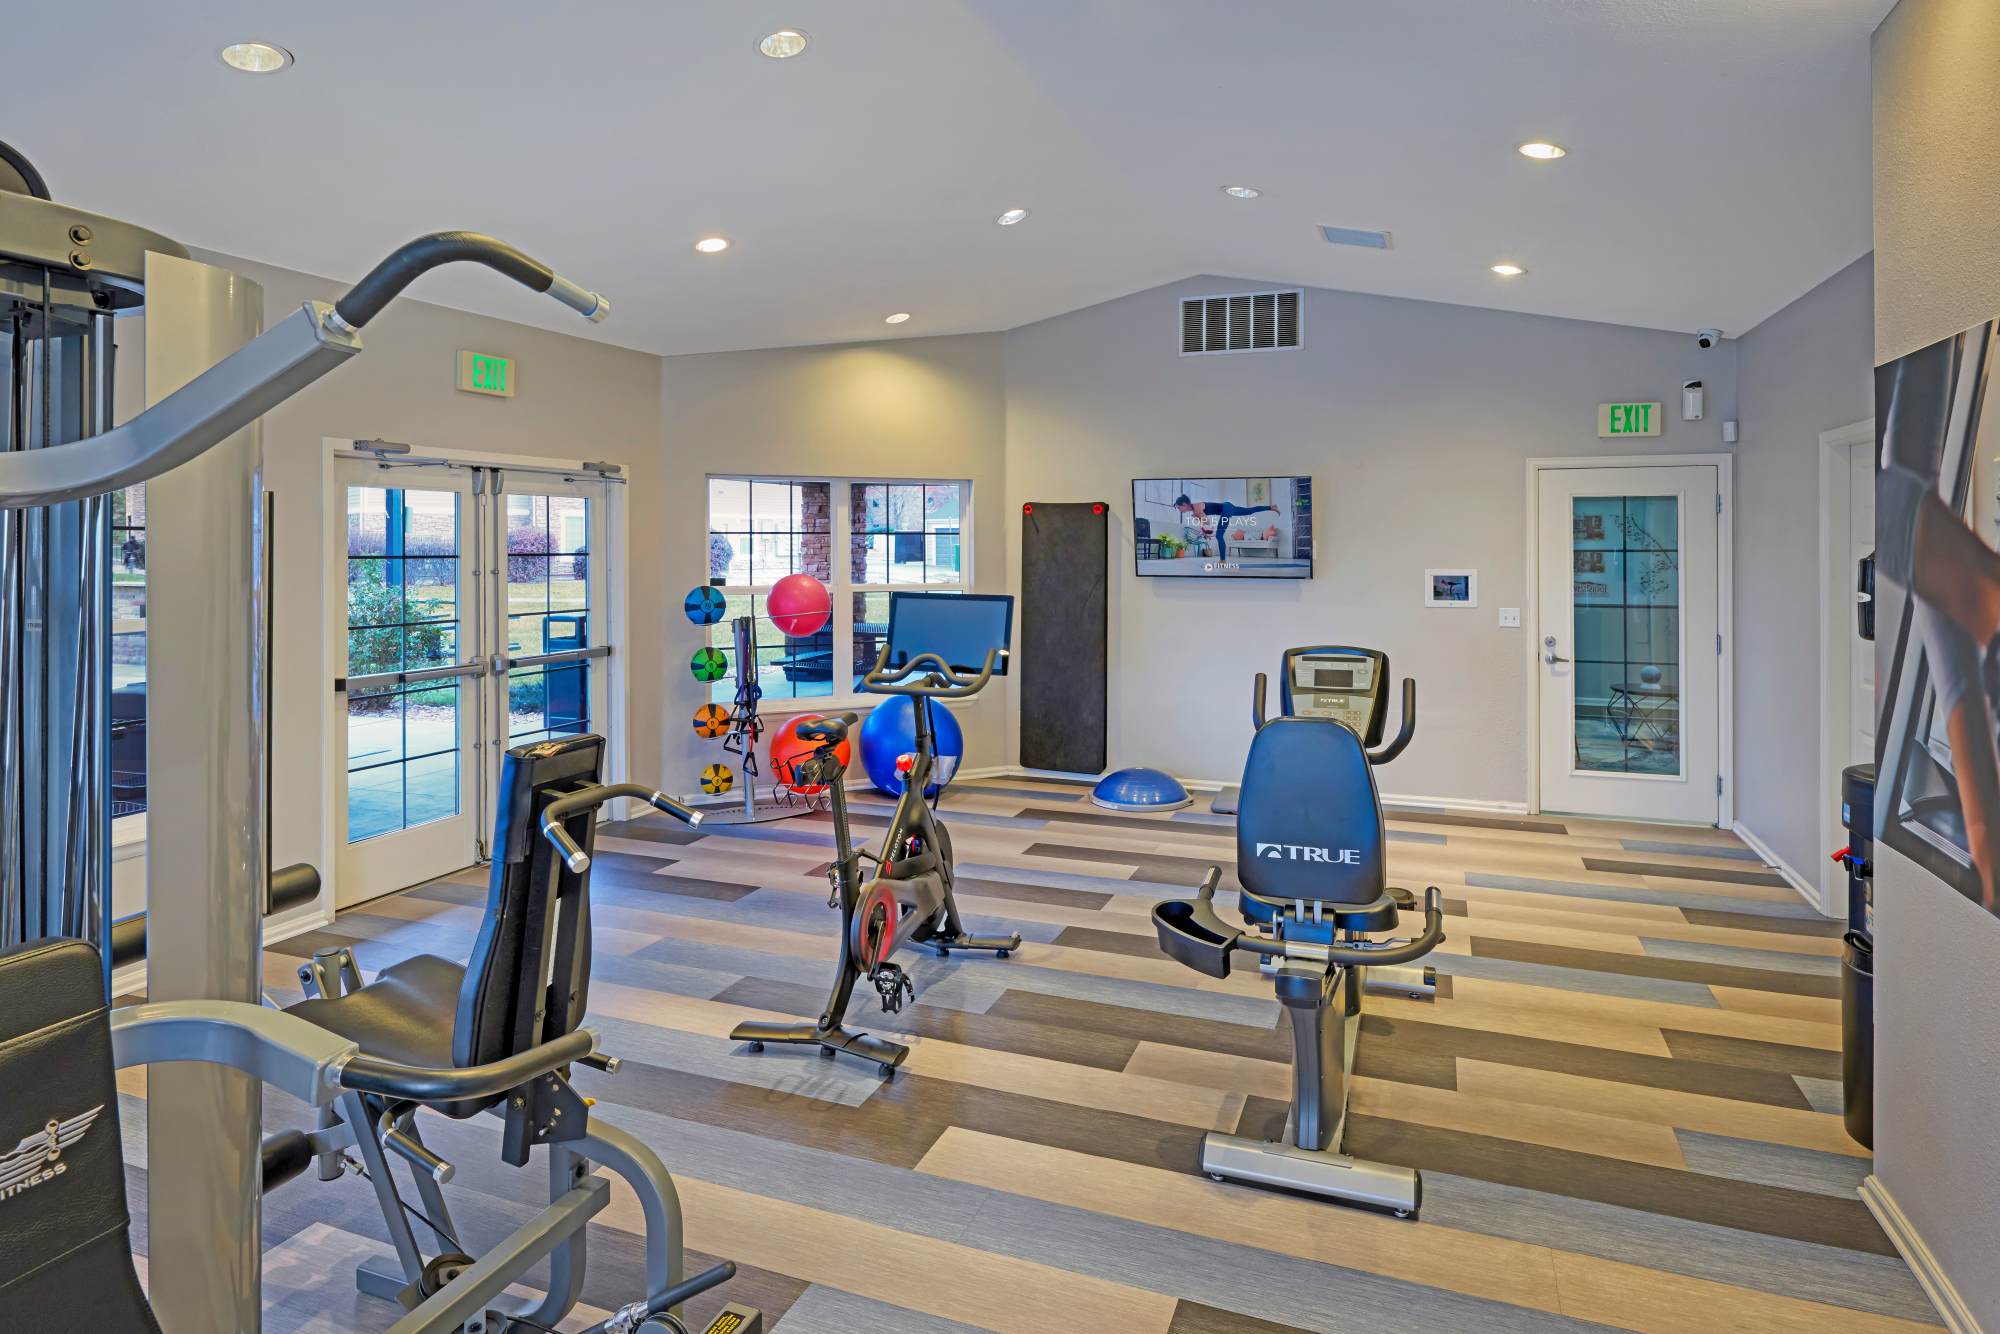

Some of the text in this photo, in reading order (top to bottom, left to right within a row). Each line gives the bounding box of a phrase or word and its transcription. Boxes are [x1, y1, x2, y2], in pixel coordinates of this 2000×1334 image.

[473, 353, 506, 391] EXIT
[1610, 404, 1652, 433] EXIT
[1185, 517, 1208, 526] TOP
[1221, 517, 1257, 526] PLAYS
[1283, 844, 1360, 865] TRUE
[0, 1163, 67, 1200] ITNESS
